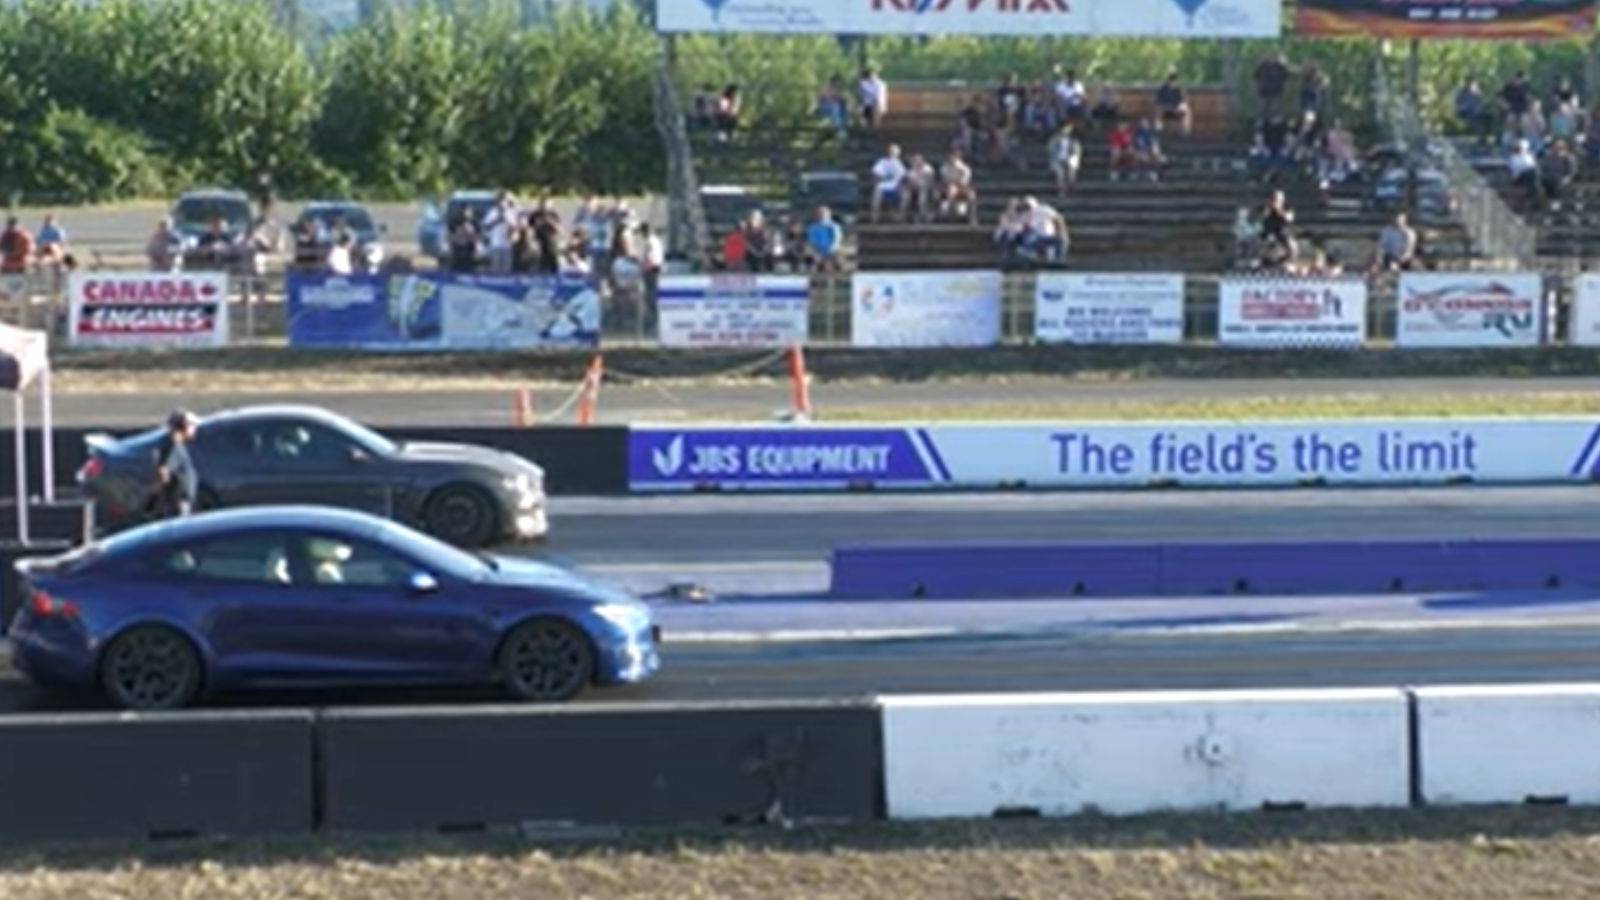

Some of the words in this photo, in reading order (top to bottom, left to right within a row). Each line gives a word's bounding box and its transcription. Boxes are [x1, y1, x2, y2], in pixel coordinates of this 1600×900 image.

[83, 280, 195, 301] CANADA
[90, 307, 202, 331] ENGINES
[1482, 312, 1532, 338] RV
[689, 445, 741, 473] JBS
[746, 444, 891, 475] EQUIPMENT
[1051, 433, 1134, 474] The
[1151, 433, 1278, 474] field's
[1293, 432, 1362, 472] the
[1378, 431, 1476, 472] limit
